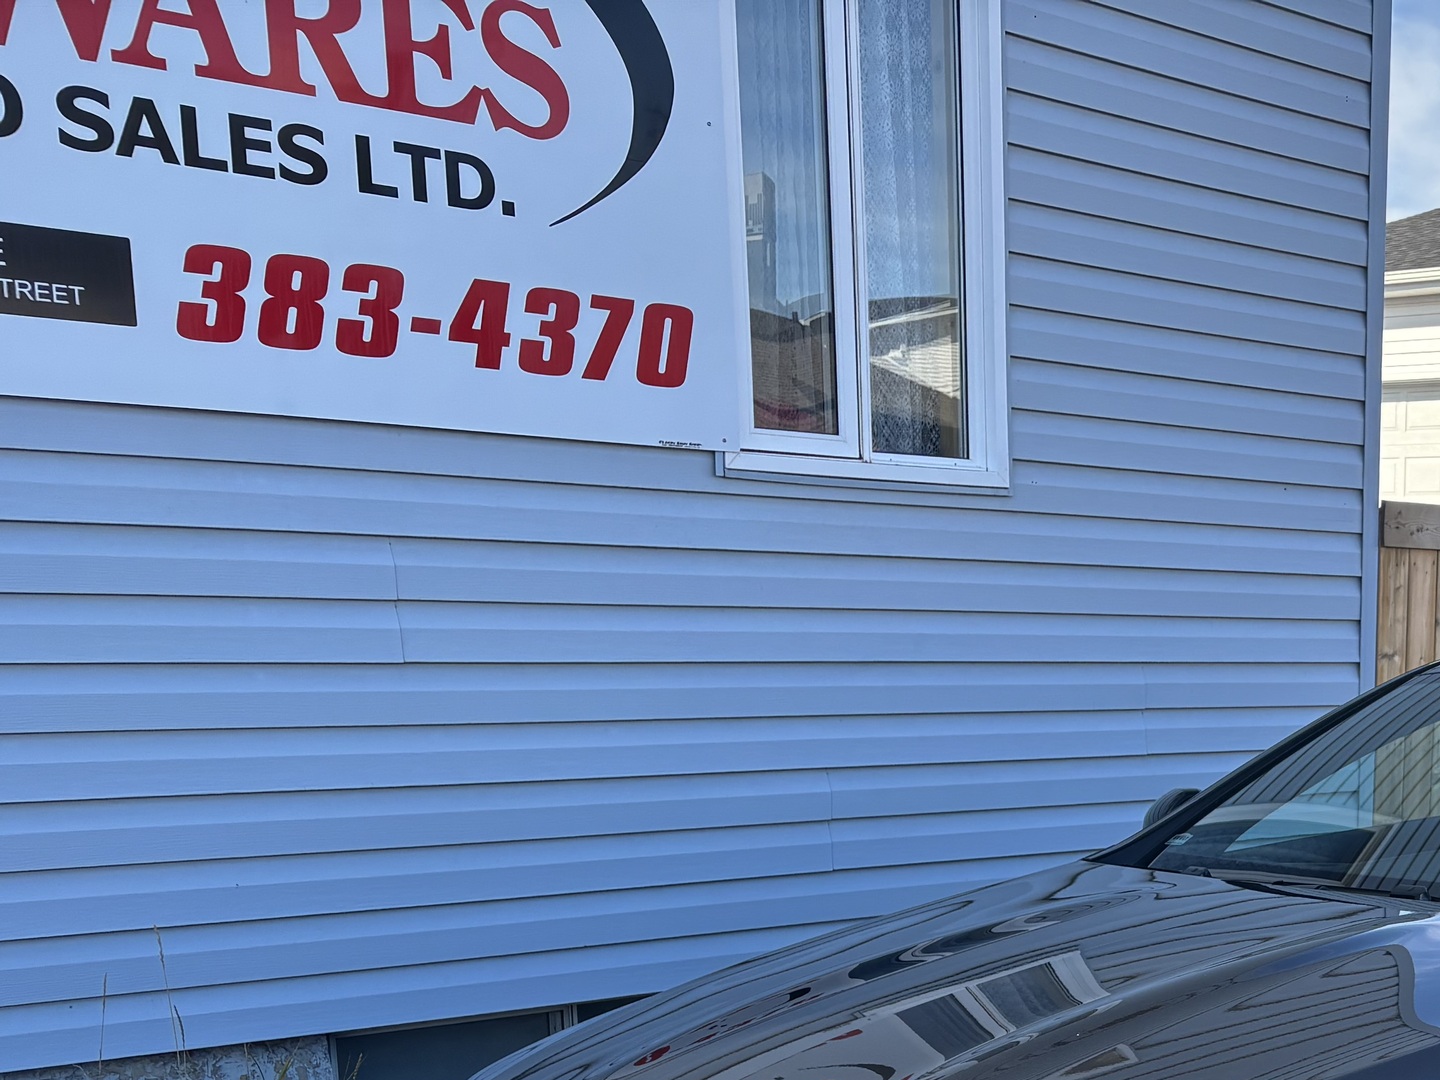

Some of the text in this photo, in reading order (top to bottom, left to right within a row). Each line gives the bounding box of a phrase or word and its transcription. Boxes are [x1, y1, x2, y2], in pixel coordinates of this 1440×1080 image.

[55, 85, 329, 187] SALES
[355, 134, 516, 218] LTD.
[176, 243, 694, 389] 383-4370
